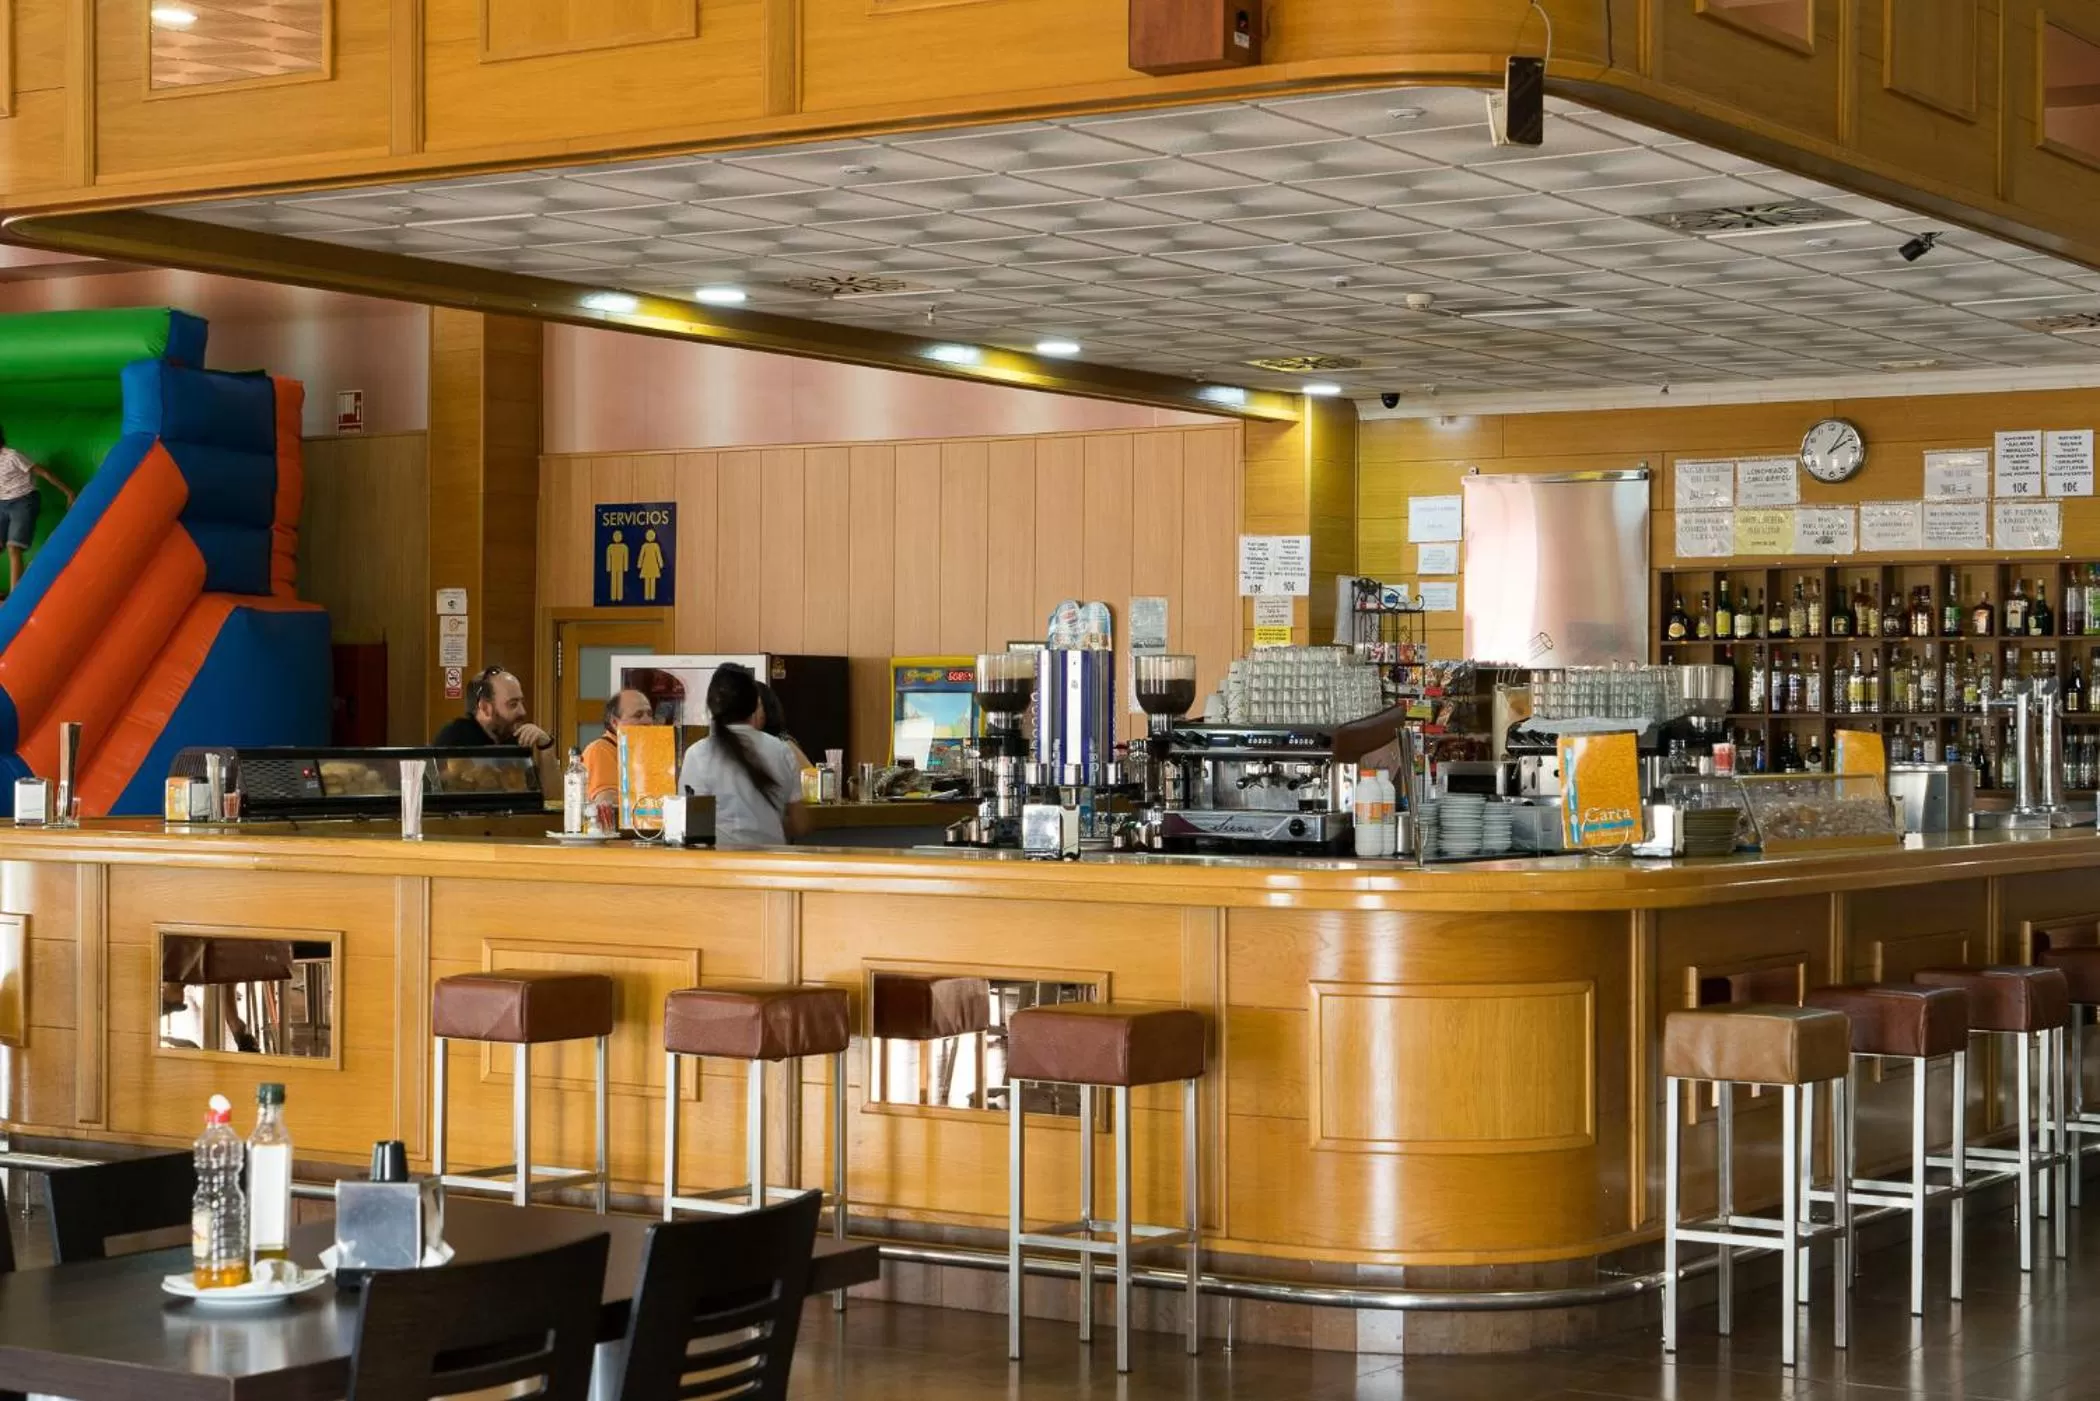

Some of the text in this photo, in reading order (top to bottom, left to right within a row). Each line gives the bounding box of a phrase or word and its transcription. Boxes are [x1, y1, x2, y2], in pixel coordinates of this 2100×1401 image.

[2012, 483, 2028, 493] 10€
[2062, 482, 2078, 492] 10€
[602, 510, 669, 526] SERVICIOS
[1585, 806, 1631, 822] Carta
